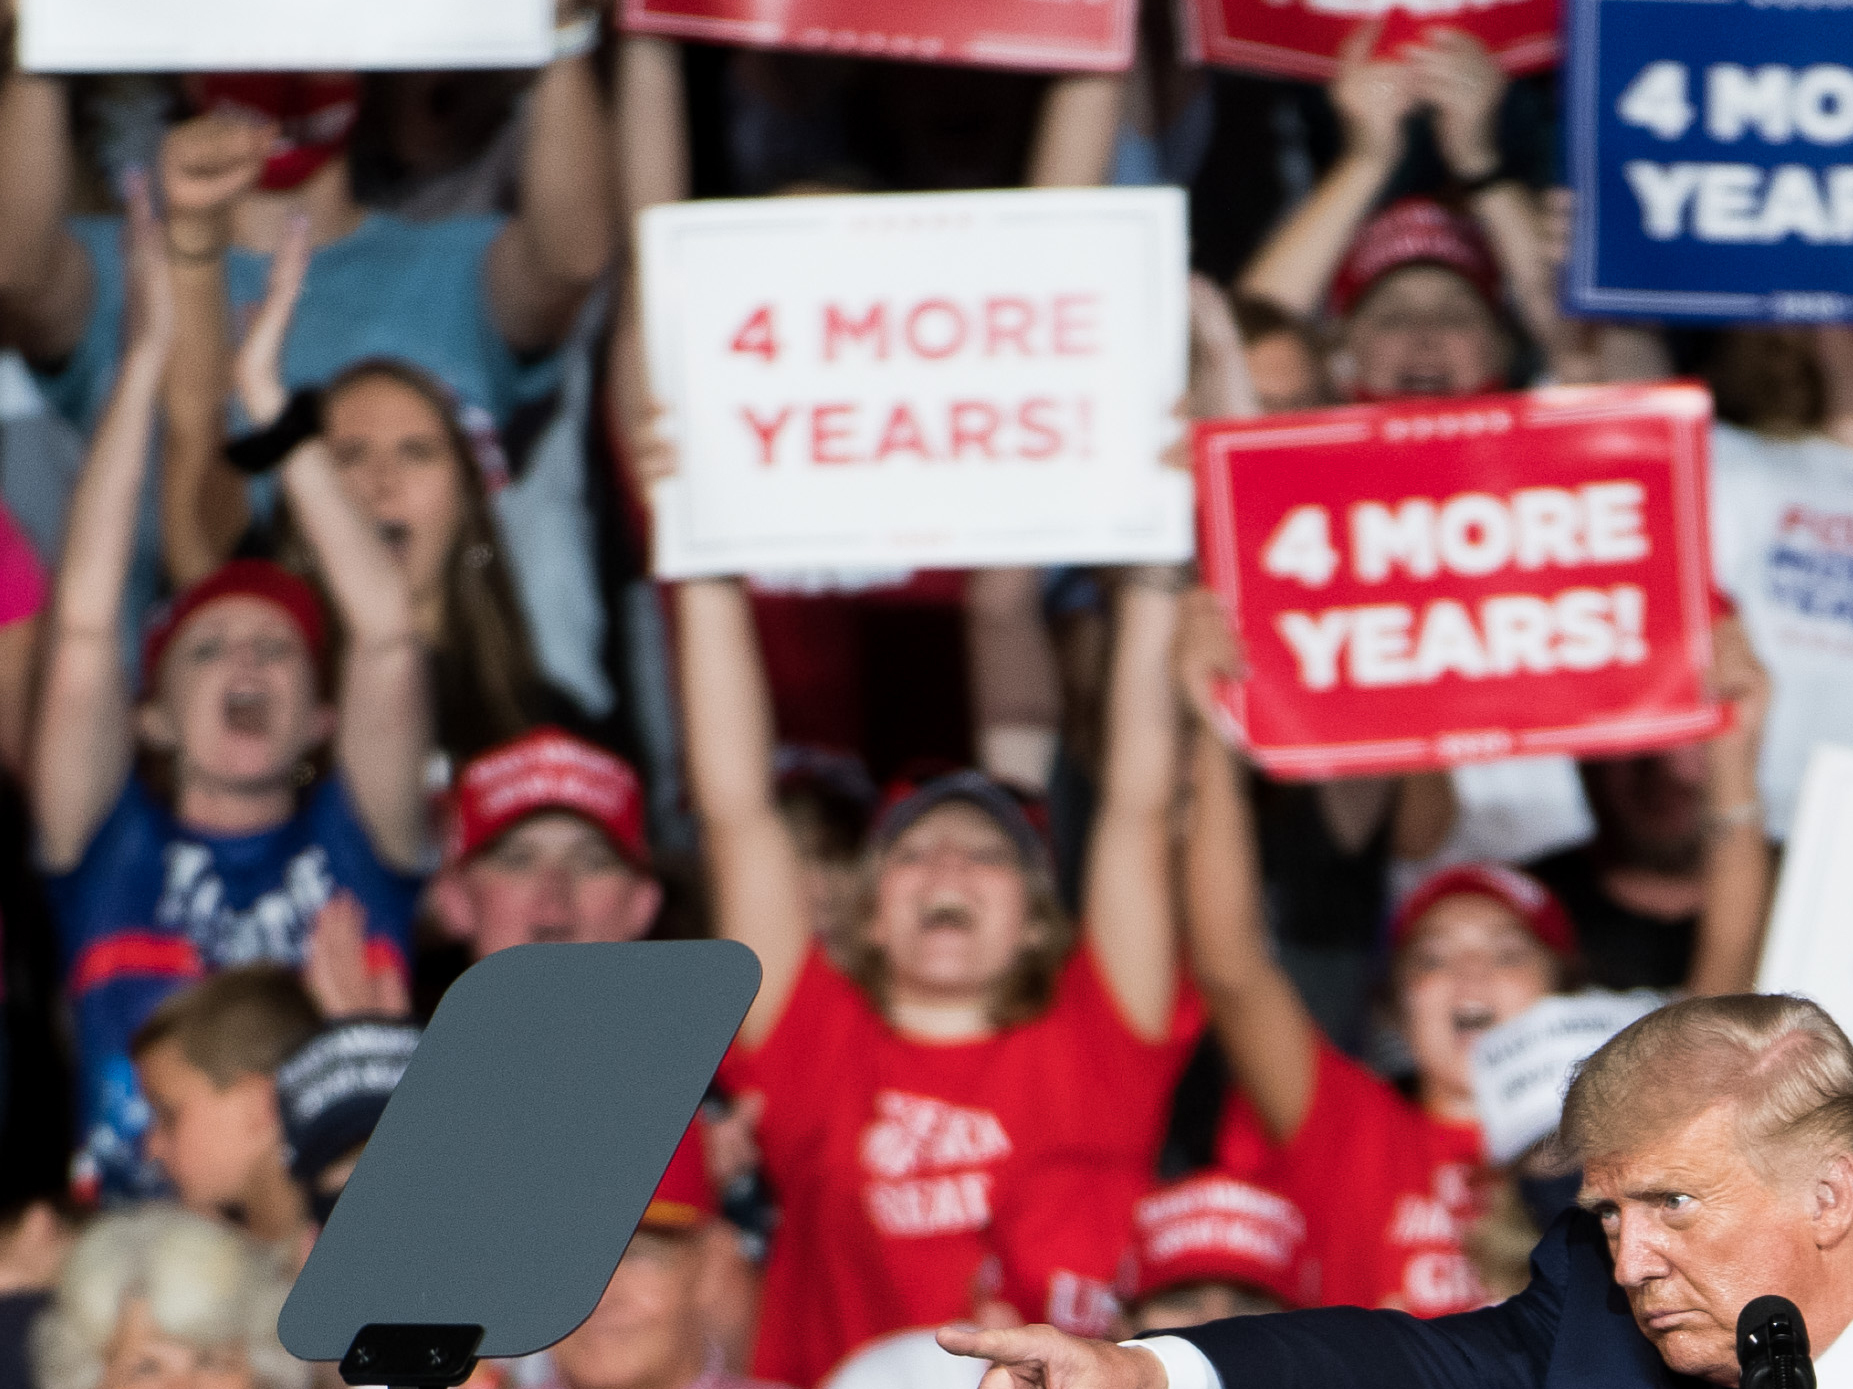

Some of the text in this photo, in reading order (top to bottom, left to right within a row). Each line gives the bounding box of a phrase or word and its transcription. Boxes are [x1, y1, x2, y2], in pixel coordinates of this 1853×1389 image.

[1617, 61, 1695, 141] 4
[727, 293, 1102, 361] 4 MORE
[740, 396, 1095, 466] YEARS!
[1260, 480, 1652, 588] 4 MORE
[1275, 586, 1648, 692] YEARS!
